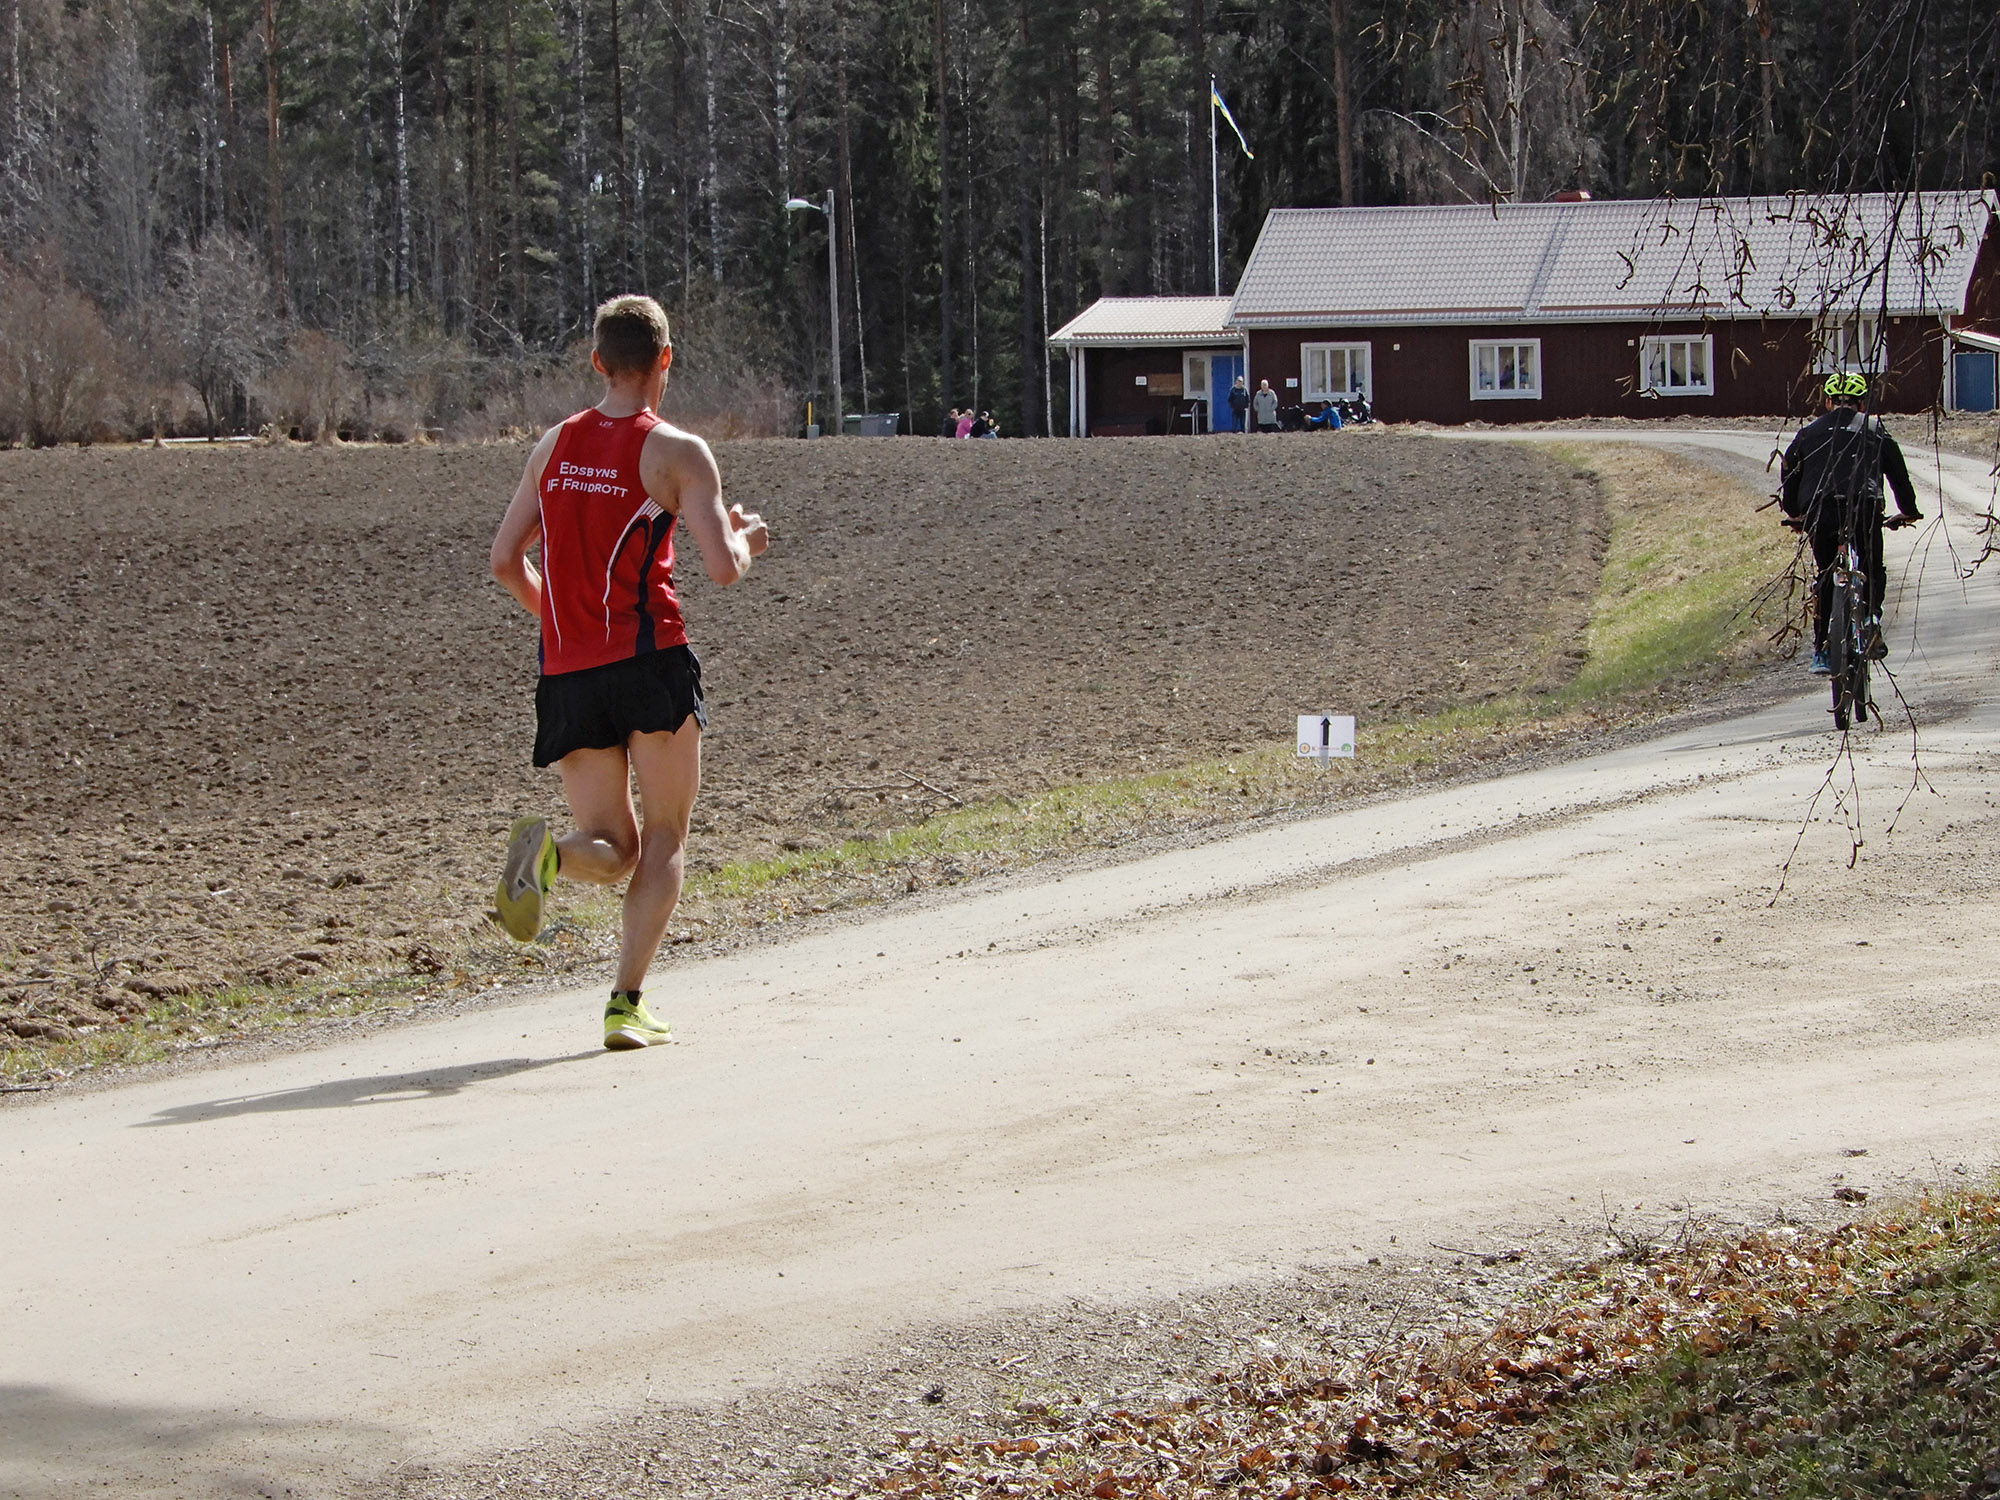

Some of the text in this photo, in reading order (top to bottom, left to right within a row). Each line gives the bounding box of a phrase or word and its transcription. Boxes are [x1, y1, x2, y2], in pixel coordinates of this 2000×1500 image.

[560, 461, 618, 479] EDSBYNS
[547, 478, 628, 498] IF FRIIDROTT
